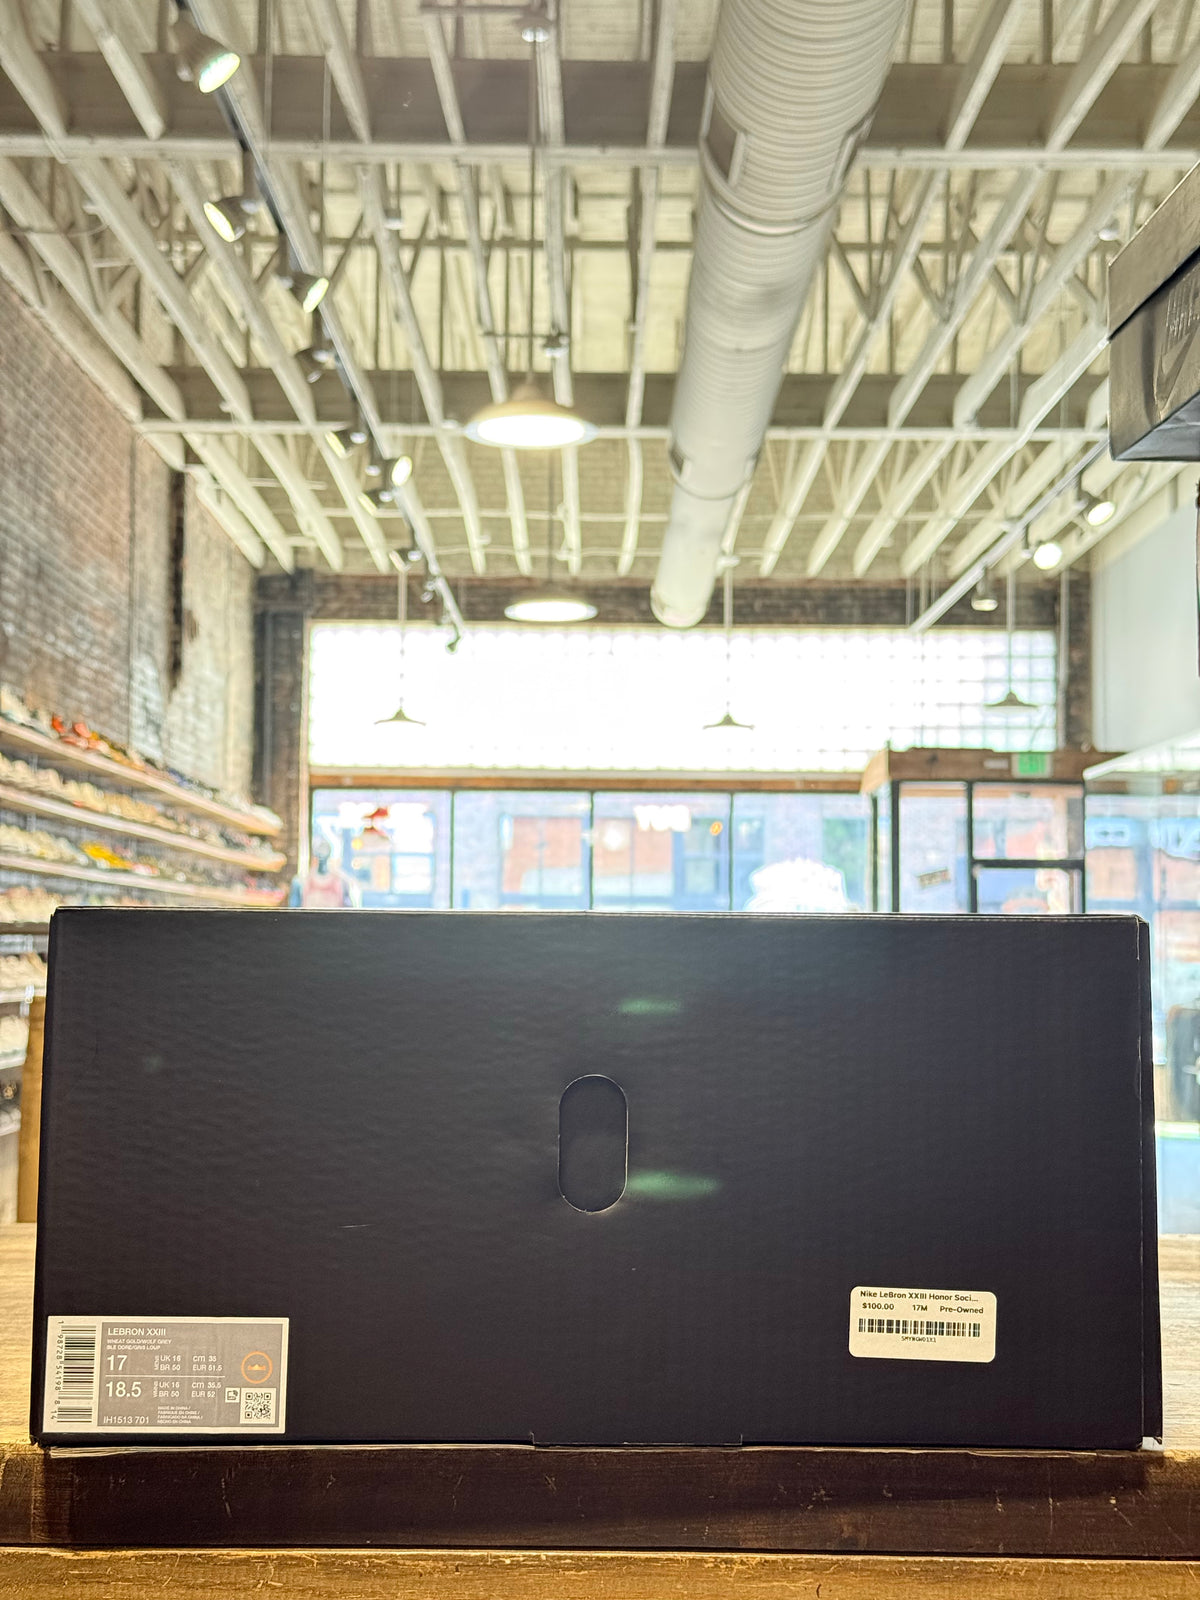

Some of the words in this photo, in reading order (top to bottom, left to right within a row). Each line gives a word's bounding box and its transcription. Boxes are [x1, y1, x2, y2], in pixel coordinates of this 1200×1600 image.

[860, 1290, 877, 1298] Nike
[879, 1291, 906, 1299] LeBron
[928, 1293, 953, 1301] Honor
[862, 1302, 894, 1310] $100.00
[939, 1305, 984, 1314] Pre-Owned
[107, 1328, 145, 1336] LEBRON
[146, 1328, 166, 1336] XXIII
[106, 1354, 128, 1371] 17
[105, 1381, 142, 1398] 18.5
[103, 1415, 133, 1424] IH1513
[134, 1416, 150, 1424] 701
